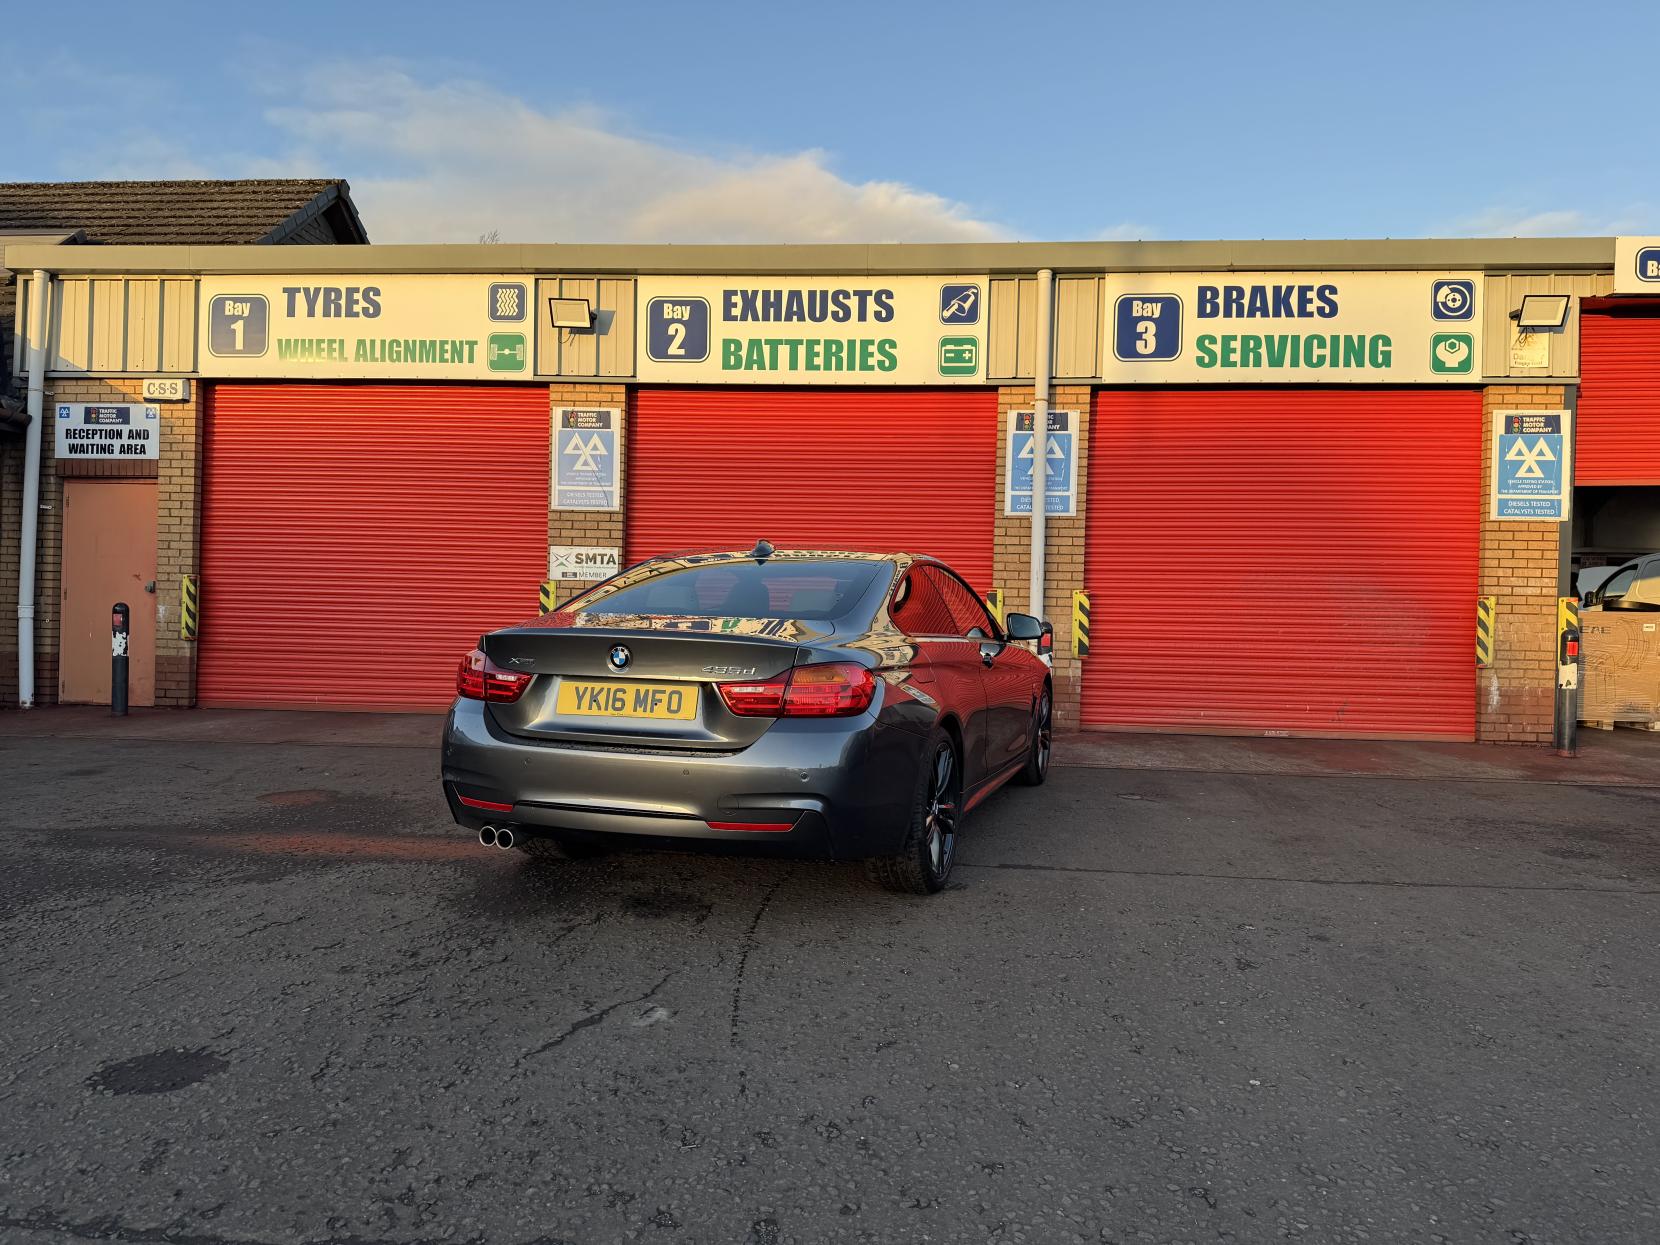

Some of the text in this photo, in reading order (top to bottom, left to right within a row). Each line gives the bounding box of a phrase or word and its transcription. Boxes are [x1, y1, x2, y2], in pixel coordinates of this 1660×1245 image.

[224, 300, 250, 316] Bay
[282, 286, 382, 318] TYRES
[664, 304, 690, 320] Bay
[722, 289, 895, 322] EXHAUSTS
[1132, 301, 1161, 318] Bay
[1197, 285, 1339, 318] BRAKES
[230, 320, 244, 350] 1
[667, 324, 686, 355] 2
[1136, 320, 1156, 354] 3
[277, 339, 478, 364] WHEEL ALIGNMENT
[722, 338, 898, 372] BATTERIES
[1196, 334, 1392, 368] SERVICING
[66, 429, 149, 440] RECEPTION AND
[68, 444, 146, 455] WAITING AREA
[575, 553, 616, 565] SMTA
[575, 686, 683, 714] YK16 MFO
